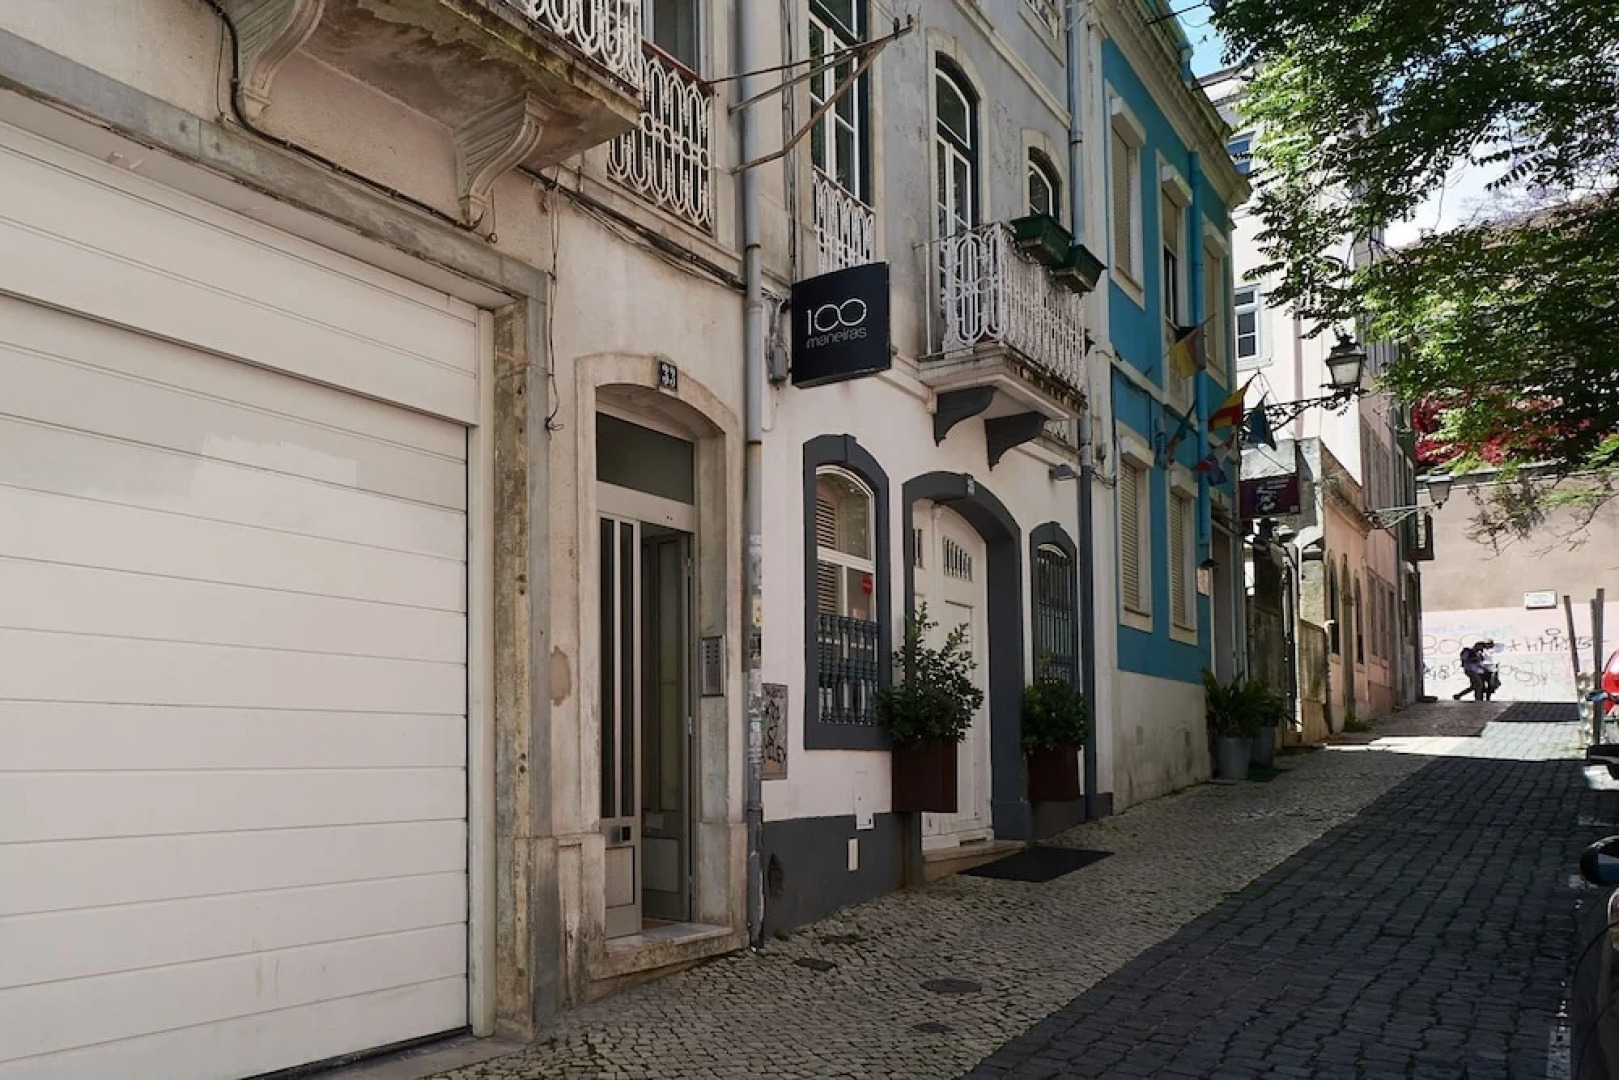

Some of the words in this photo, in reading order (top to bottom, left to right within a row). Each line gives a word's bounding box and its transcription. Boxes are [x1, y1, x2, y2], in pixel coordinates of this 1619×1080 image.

[806, 298, 867, 336] 100
[806, 326, 867, 349] maneiras
[661, 363, 676, 388] 33
